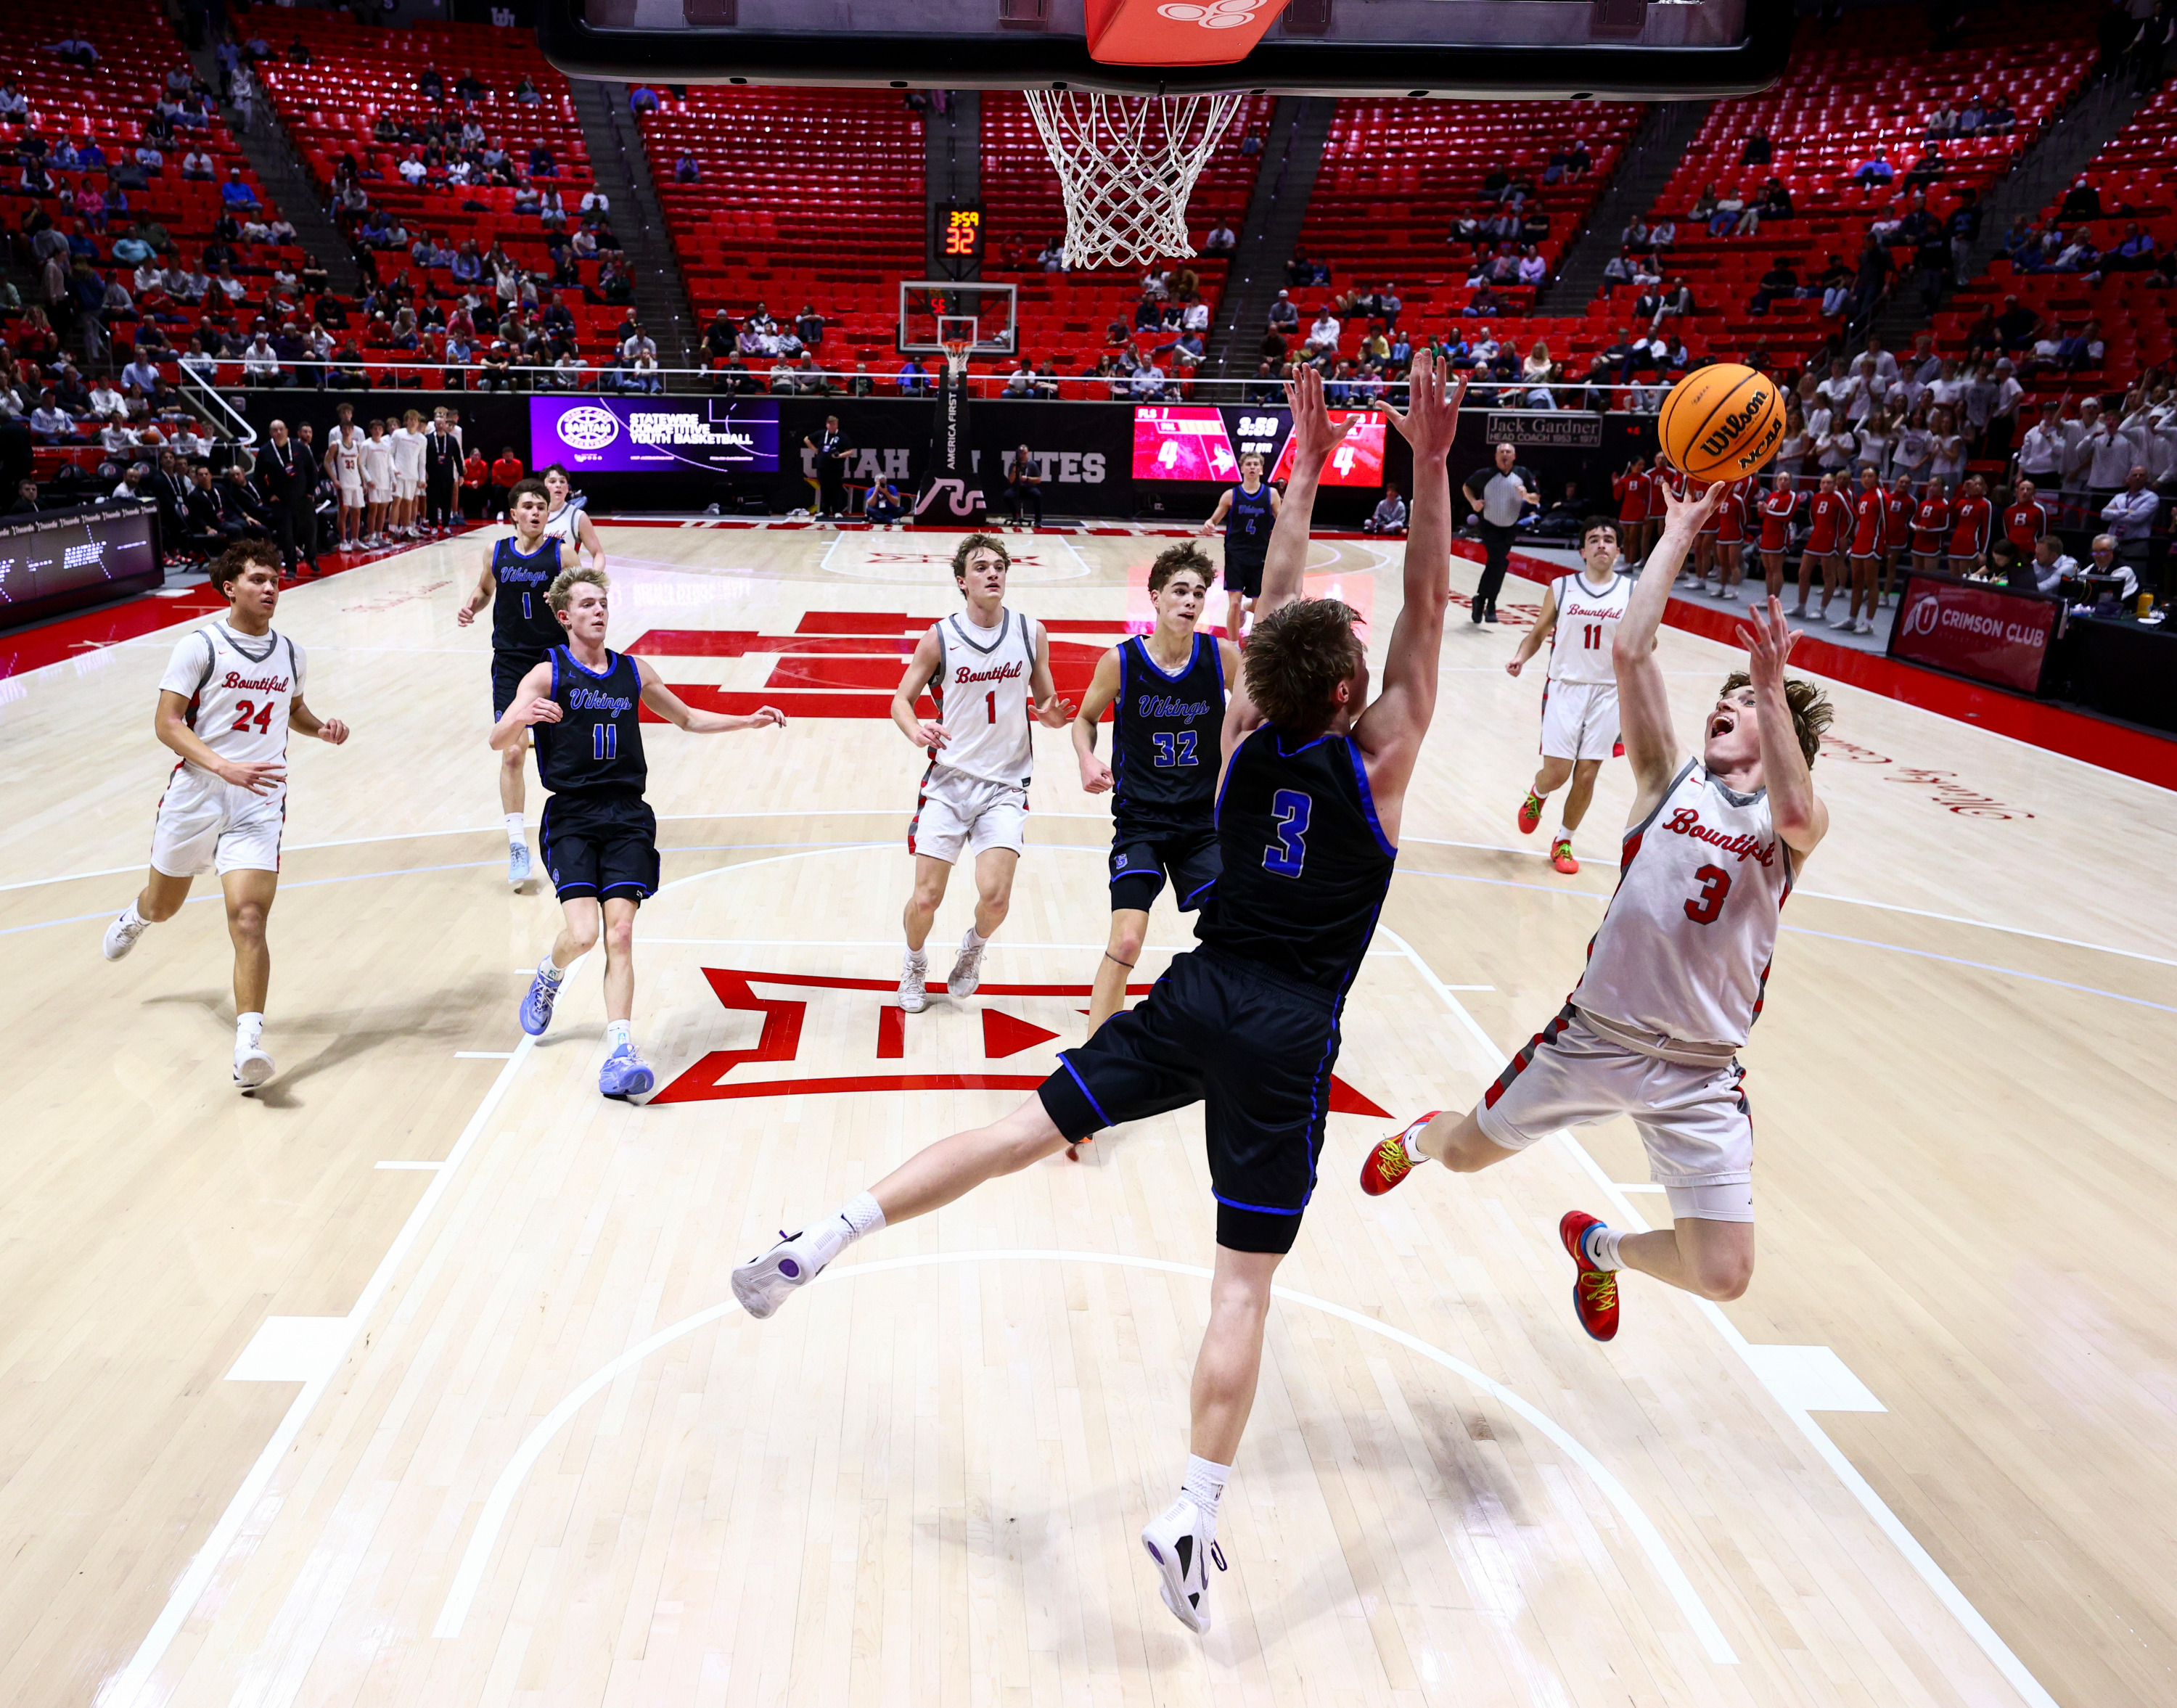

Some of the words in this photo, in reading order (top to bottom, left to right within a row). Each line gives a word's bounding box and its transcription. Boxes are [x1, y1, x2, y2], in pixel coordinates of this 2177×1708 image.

[951, 211, 979, 227] 3:59
[946, 227, 975, 254] 32
[629, 413, 699, 425] STATEWIDE
[947, 392, 956, 422] FIRST
[1137, 408, 1157, 419] FLS
[1162, 407, 1169, 419] 1
[565, 422, 611, 434] BANTAM
[629, 423, 710, 435] COMPETITIVE
[1237, 416, 1279, 437] 3:59
[1490, 432, 1515, 441] HEAD
[1517, 433, 1550, 442] COACH
[1491, 417, 1525, 432] Jack
[1532, 418, 1599, 435] Gardner
[1700, 390, 1768, 457] Wilson
[630, 433, 671, 445] YOUTH
[673, 433, 754, 445] BASKETBALL
[947, 424, 956, 469] AMERICA
[1738, 416, 1783, 469] NCAA
[1158, 441, 1178, 469] 4
[1332, 447, 1354, 476] 4
[1817, 501, 1829, 514] B
[2014, 512, 2027, 526] B
[1246, 519, 1256, 535] 4
[501, 566, 549, 588] Vikings
[522, 592, 532, 619] 1
[1567, 604, 1623, 621] Bountiful
[1583, 623, 1602, 650] 11
[1941, 608, 2004, 638] CRIMSON
[2006, 623, 2045, 648] CLUB
[221, 671, 290, 695] Bountiful
[954, 660, 1022, 684] Bountiful
[570, 688, 633, 718] Vikings
[985, 690, 996, 724] 1
[1138, 694, 1210, 725] Vikings
[231, 699, 275, 735] 24
[592, 723, 618, 760] 11
[1152, 729, 1200, 768] 32
[1261, 788, 1313, 879] 3
[1683, 863, 1732, 926] 3
